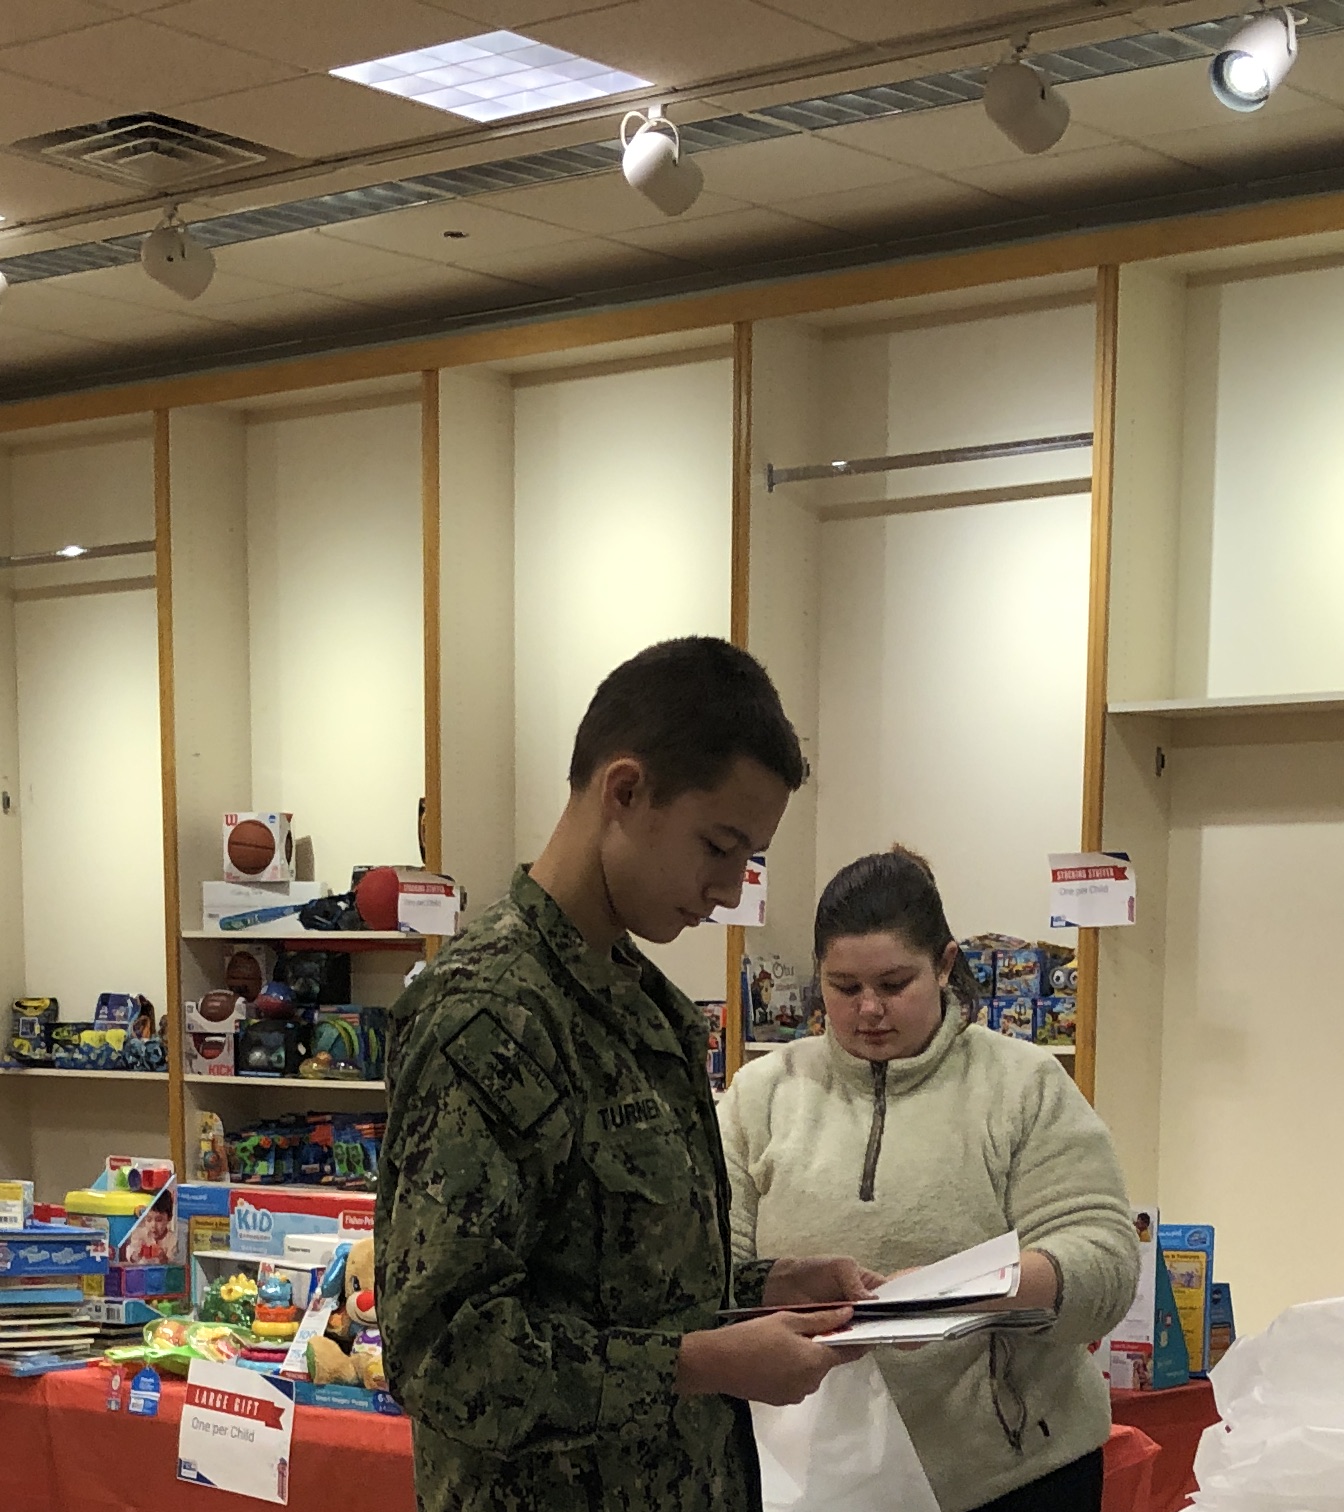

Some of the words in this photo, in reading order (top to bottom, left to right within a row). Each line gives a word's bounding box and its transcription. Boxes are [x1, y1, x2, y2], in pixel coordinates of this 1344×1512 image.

[1057, 869, 1086, 880] STOCKING
[1088, 867, 1114, 879] STUFFER
[237, 1209, 273, 1232] KID
[194, 1388, 228, 1410] LARGE
[234, 1397, 260, 1416] GIFT
[192, 1417, 210, 1433] One
[212, 1423, 228, 1436] per
[230, 1425, 255, 1443] Child
